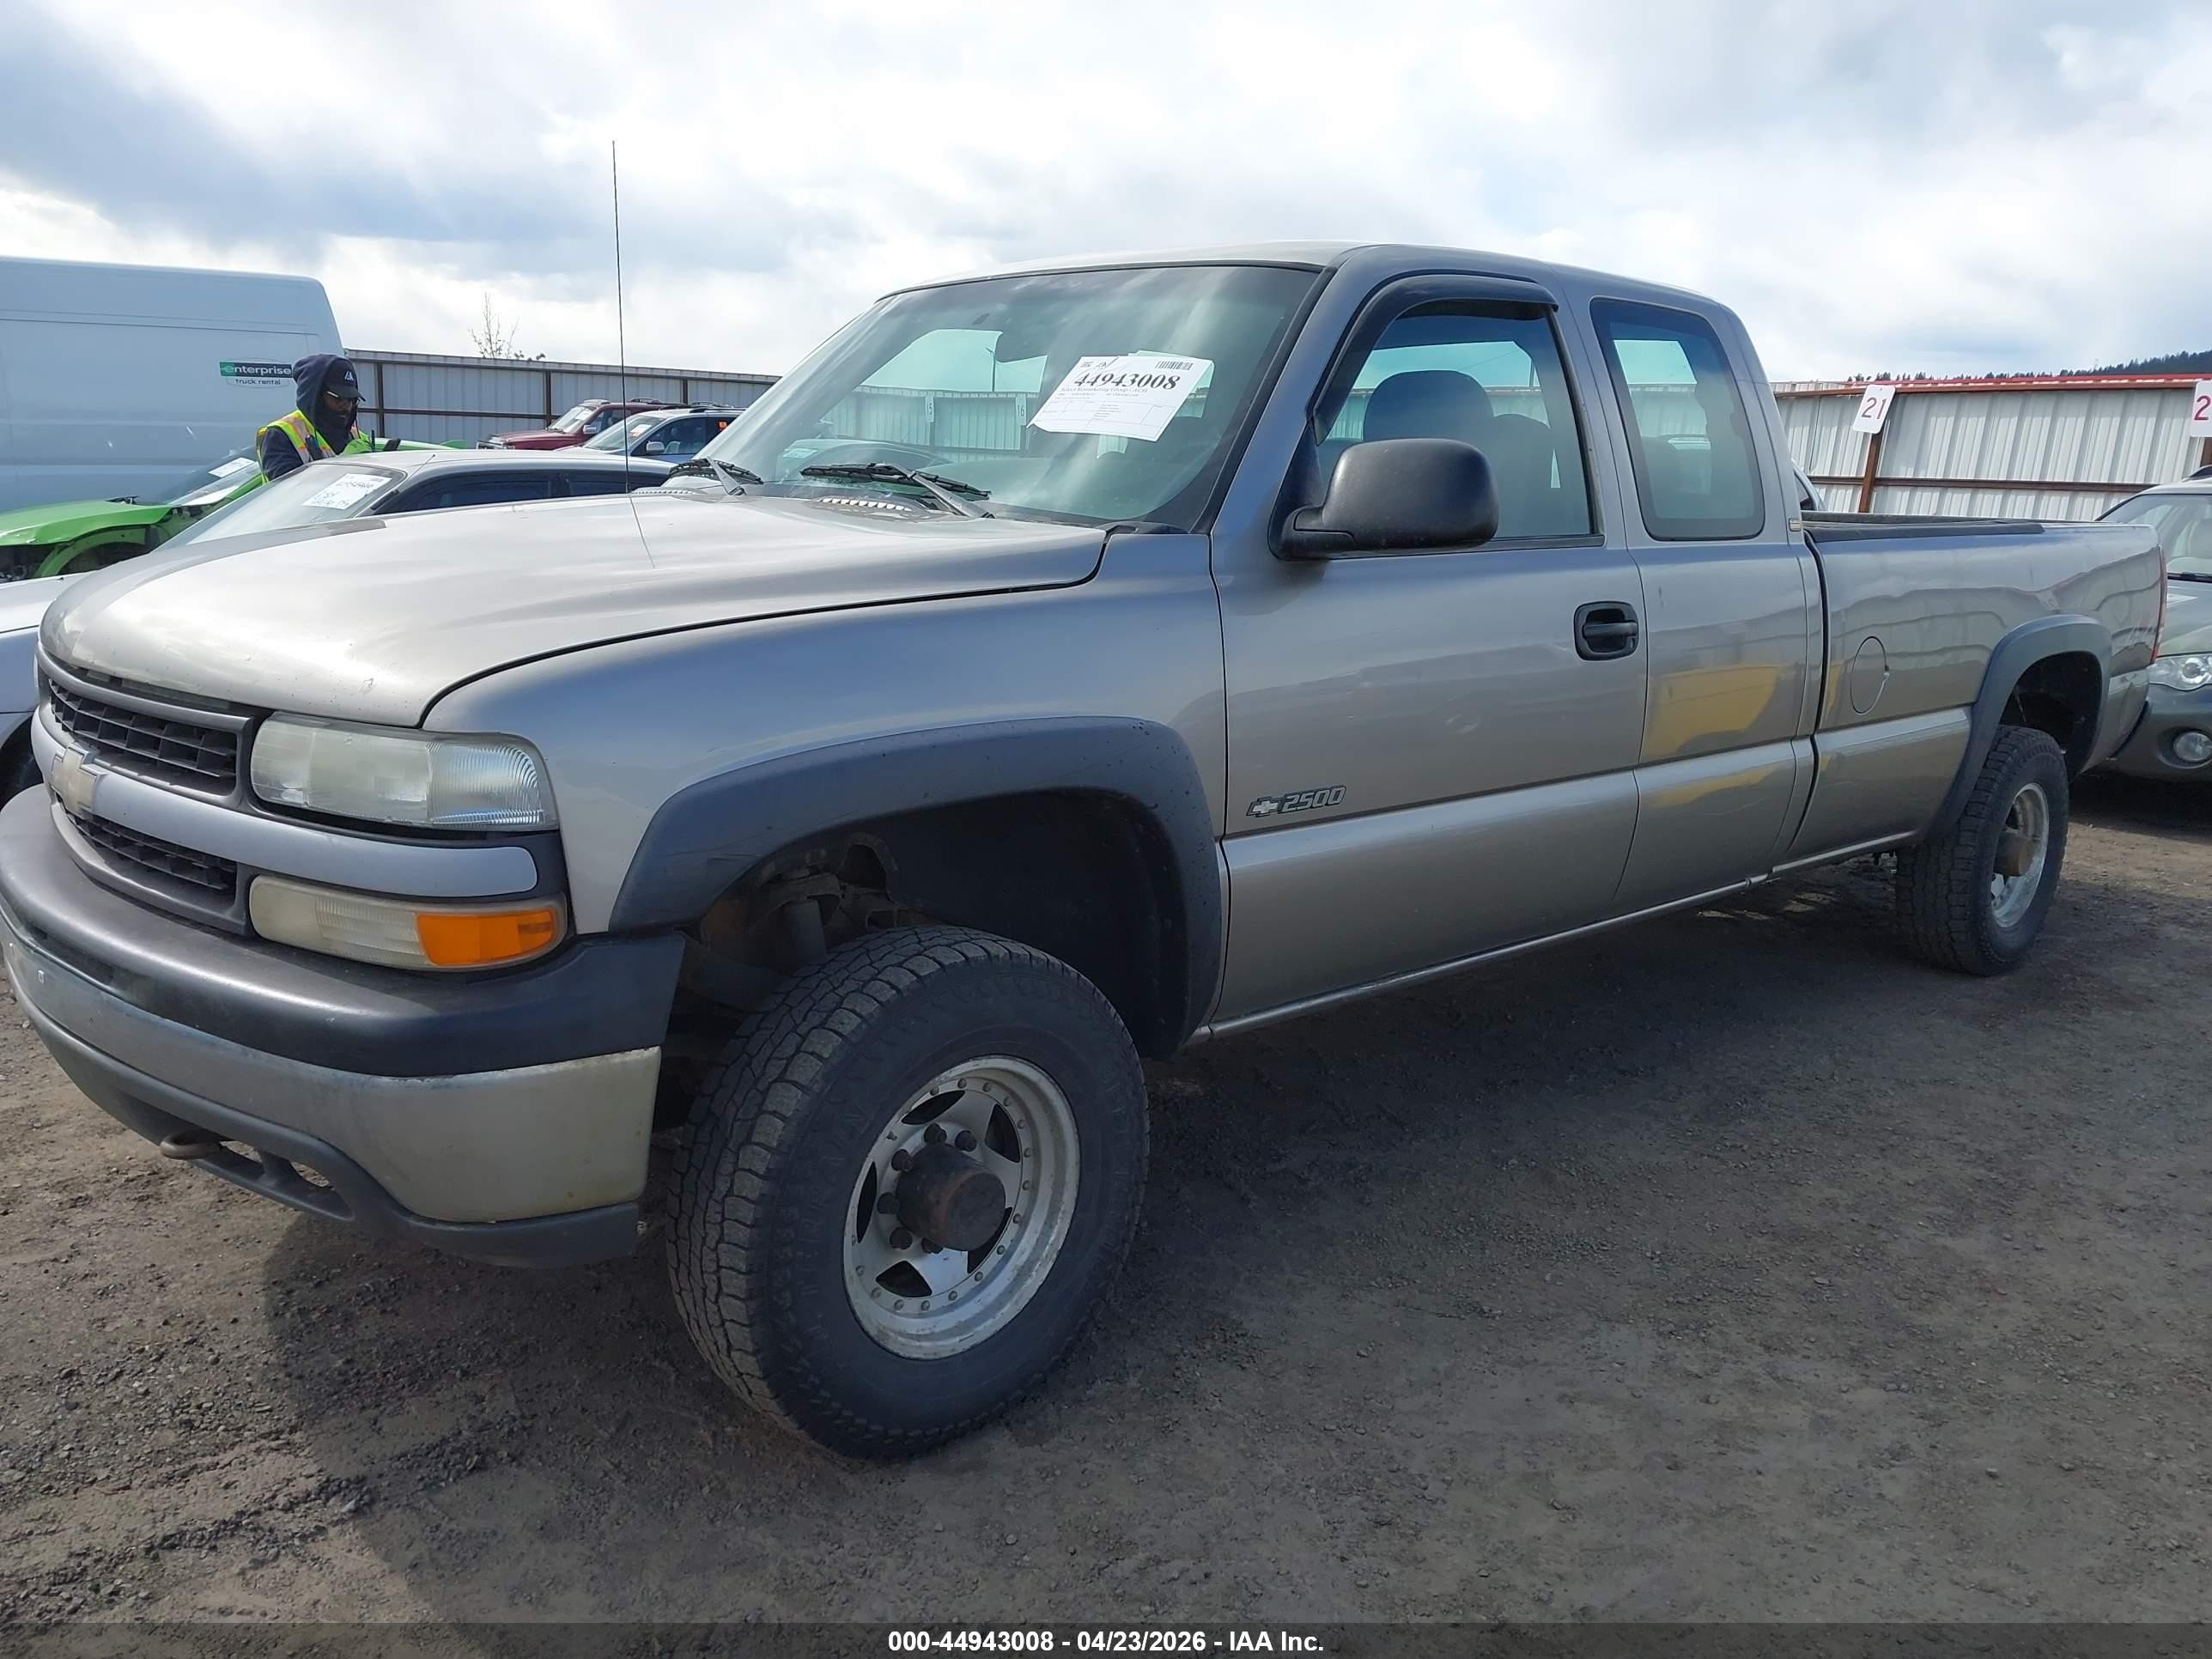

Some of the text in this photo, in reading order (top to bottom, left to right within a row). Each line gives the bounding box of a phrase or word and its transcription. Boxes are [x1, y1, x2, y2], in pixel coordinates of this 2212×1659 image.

[221, 364, 292, 376] enterprise
[1074, 372, 1182, 390] 44943008
[1017, 404, 1024, 417] 16
[1861, 397, 1887, 420] 21
[2193, 395, 2212, 421] 2
[1282, 787, 1346, 813] 2500
